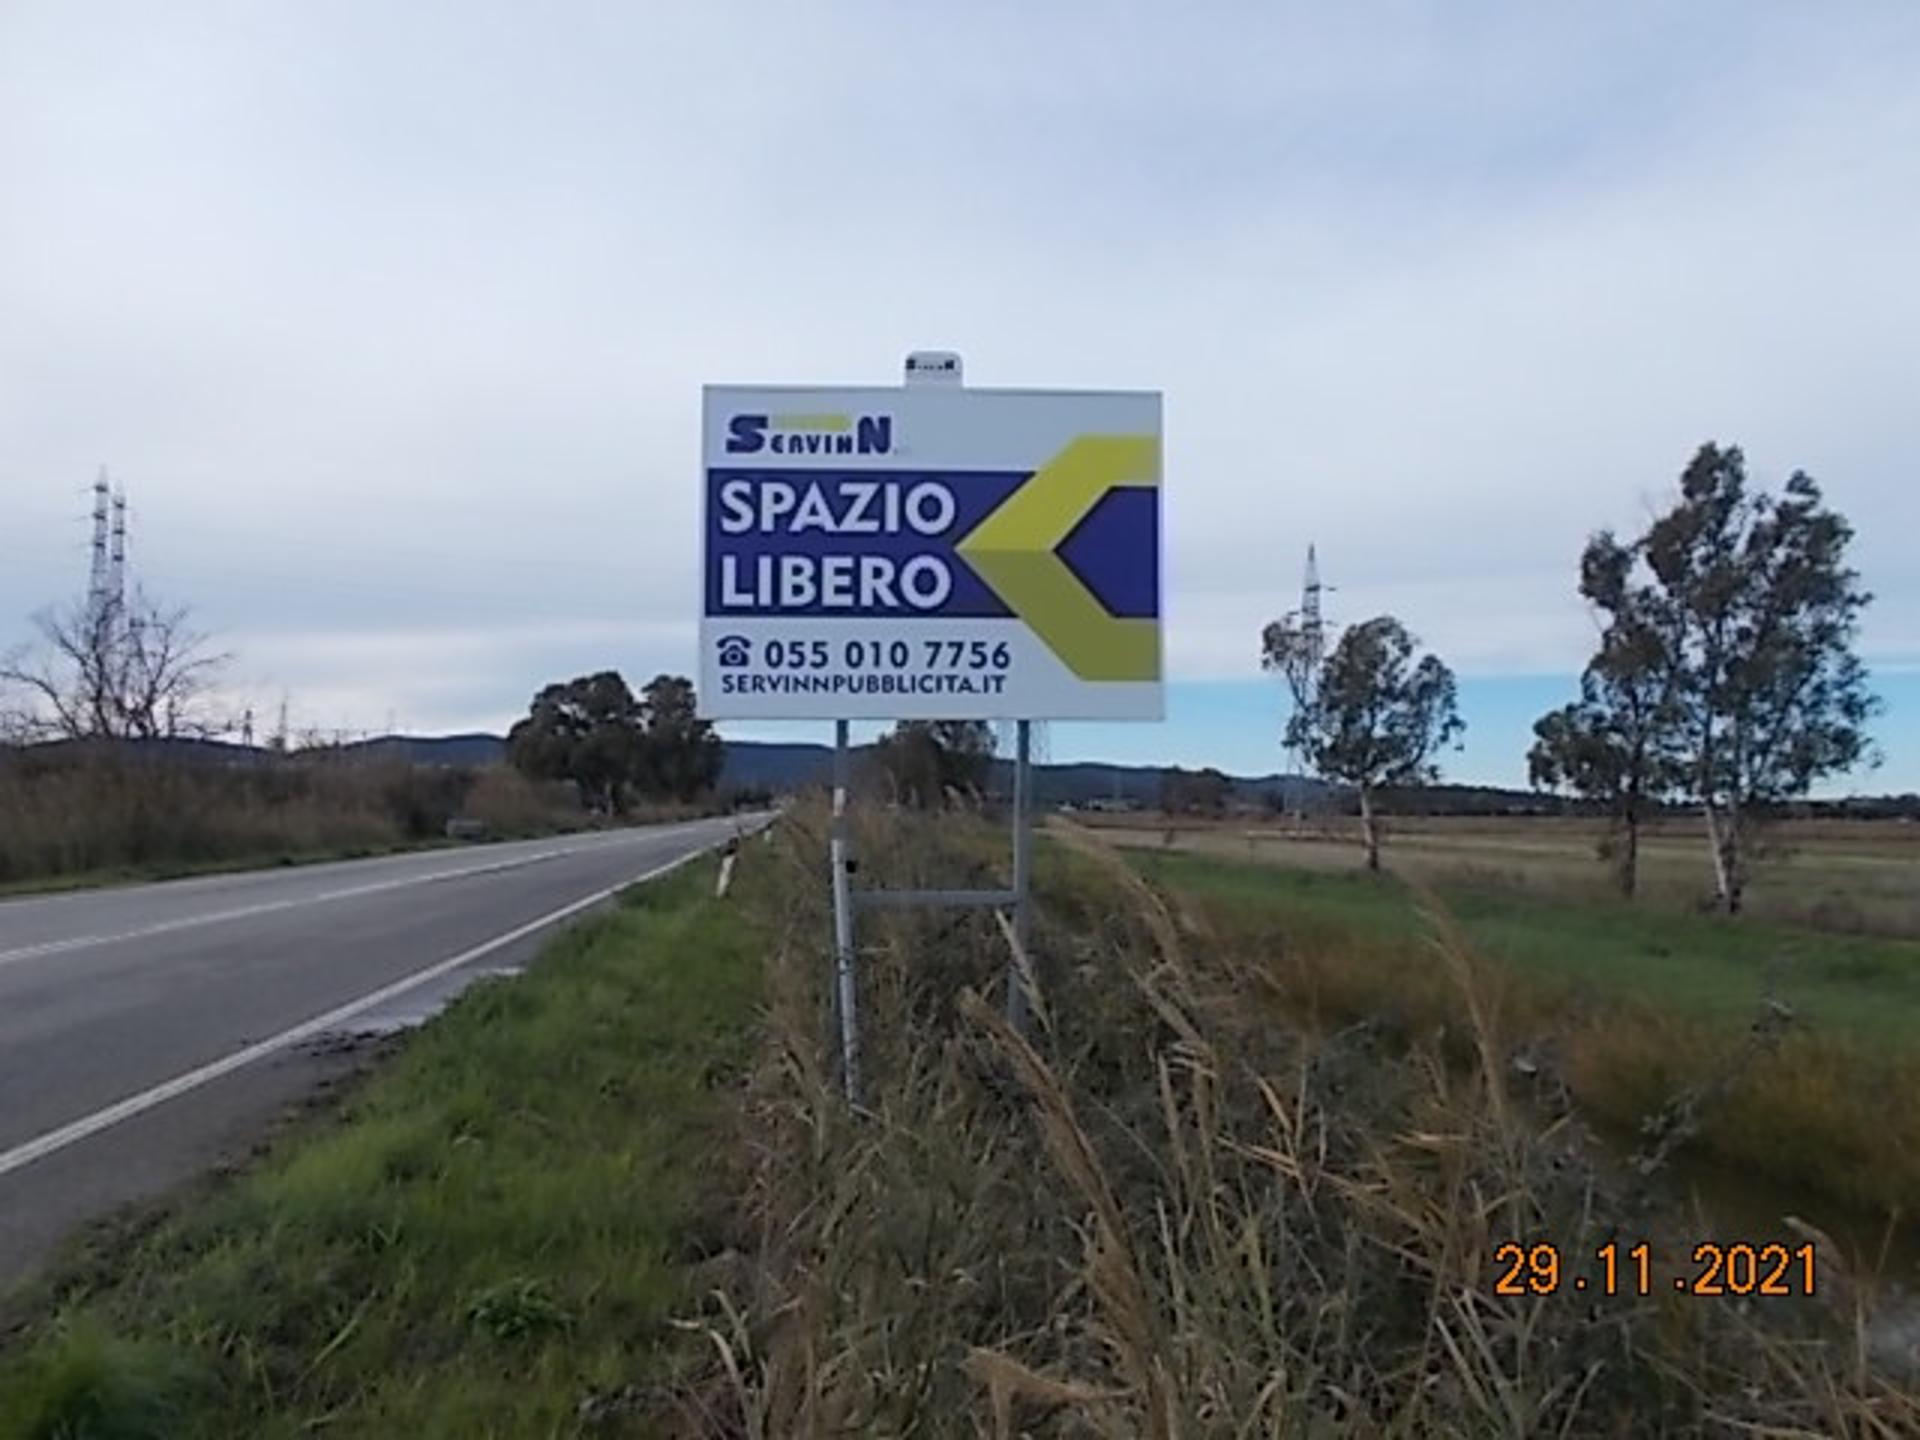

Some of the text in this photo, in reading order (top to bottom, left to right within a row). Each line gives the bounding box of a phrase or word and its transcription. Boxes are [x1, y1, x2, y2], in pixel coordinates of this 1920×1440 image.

[720, 481, 956, 535] SPAZIO
[722, 555, 952, 609] LIBERO
[764, 640, 1011, 669] 055 010 7756
[721, 673, 1007, 694] SERVINNPUBBLICITA.IT
